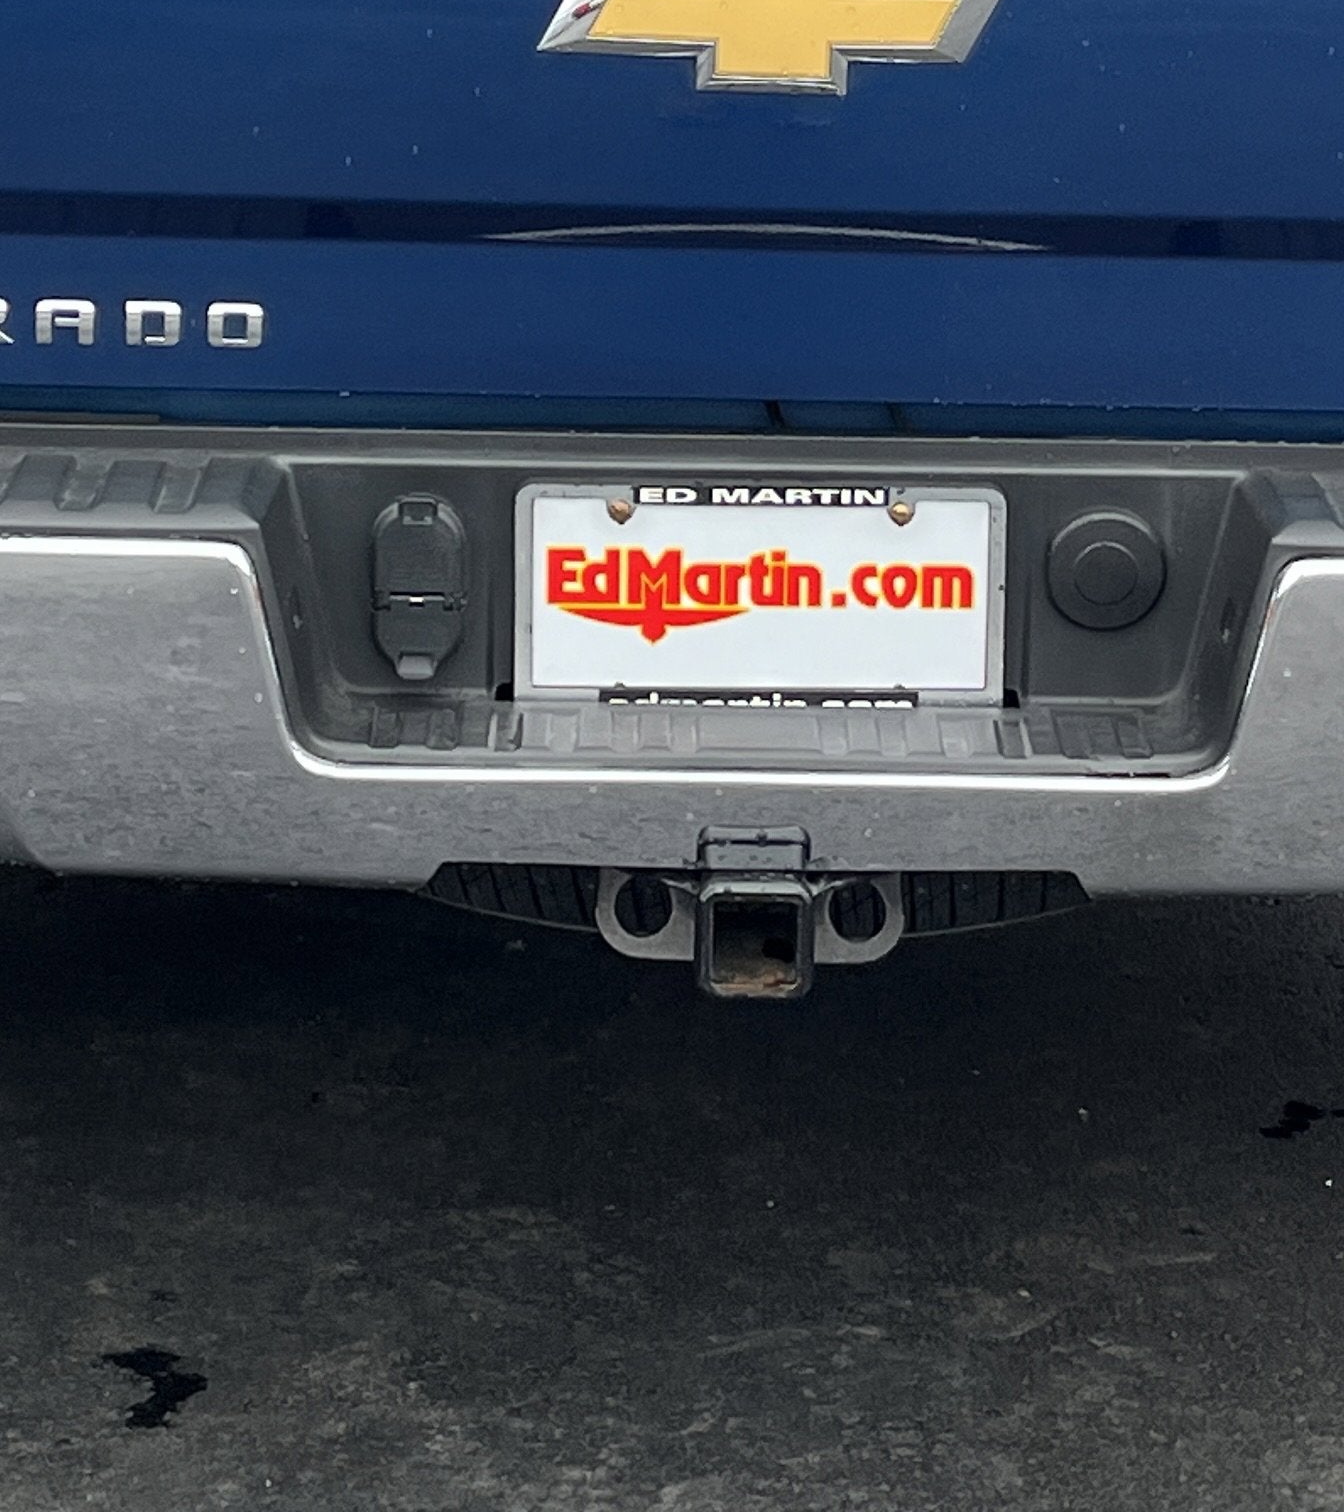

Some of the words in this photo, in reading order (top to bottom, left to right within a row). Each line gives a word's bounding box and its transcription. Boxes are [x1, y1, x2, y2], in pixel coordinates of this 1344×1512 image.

[638, 487, 698, 504] ED
[711, 488, 886, 506] MARTIN
[546, 545, 975, 618] EdMartin.com
